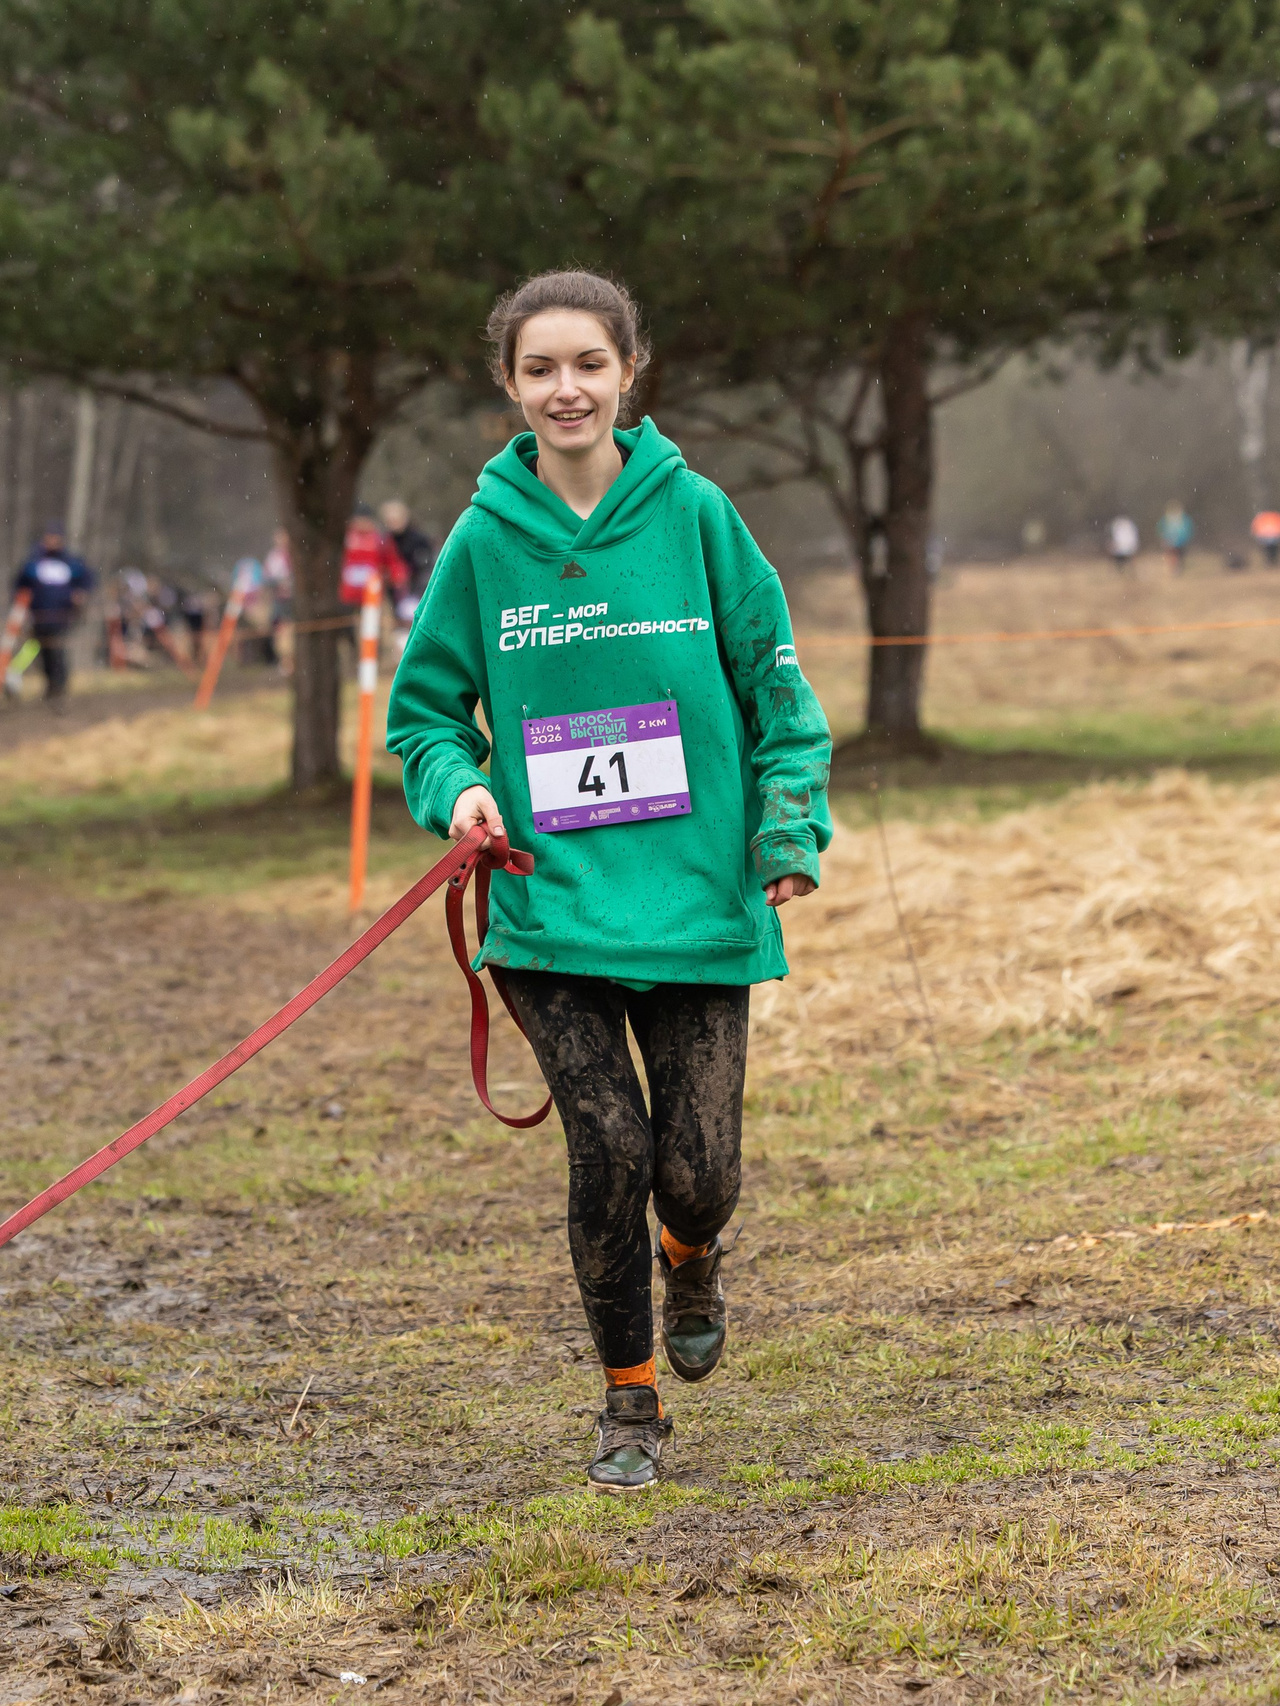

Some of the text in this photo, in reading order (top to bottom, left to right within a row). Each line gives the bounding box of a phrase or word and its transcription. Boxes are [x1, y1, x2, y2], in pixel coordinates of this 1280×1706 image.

[500, 603, 550, 629] БЕГ
[568, 602, 609, 620] МОЯ
[529, 723, 562, 735] 11/04
[569, 712, 613, 729] КРОСС
[570, 717, 628, 740] БЫСТРЫЙ
[637, 720, 646, 729] 2
[531, 734, 563, 745] 2026
[577, 751, 630, 797] 41
